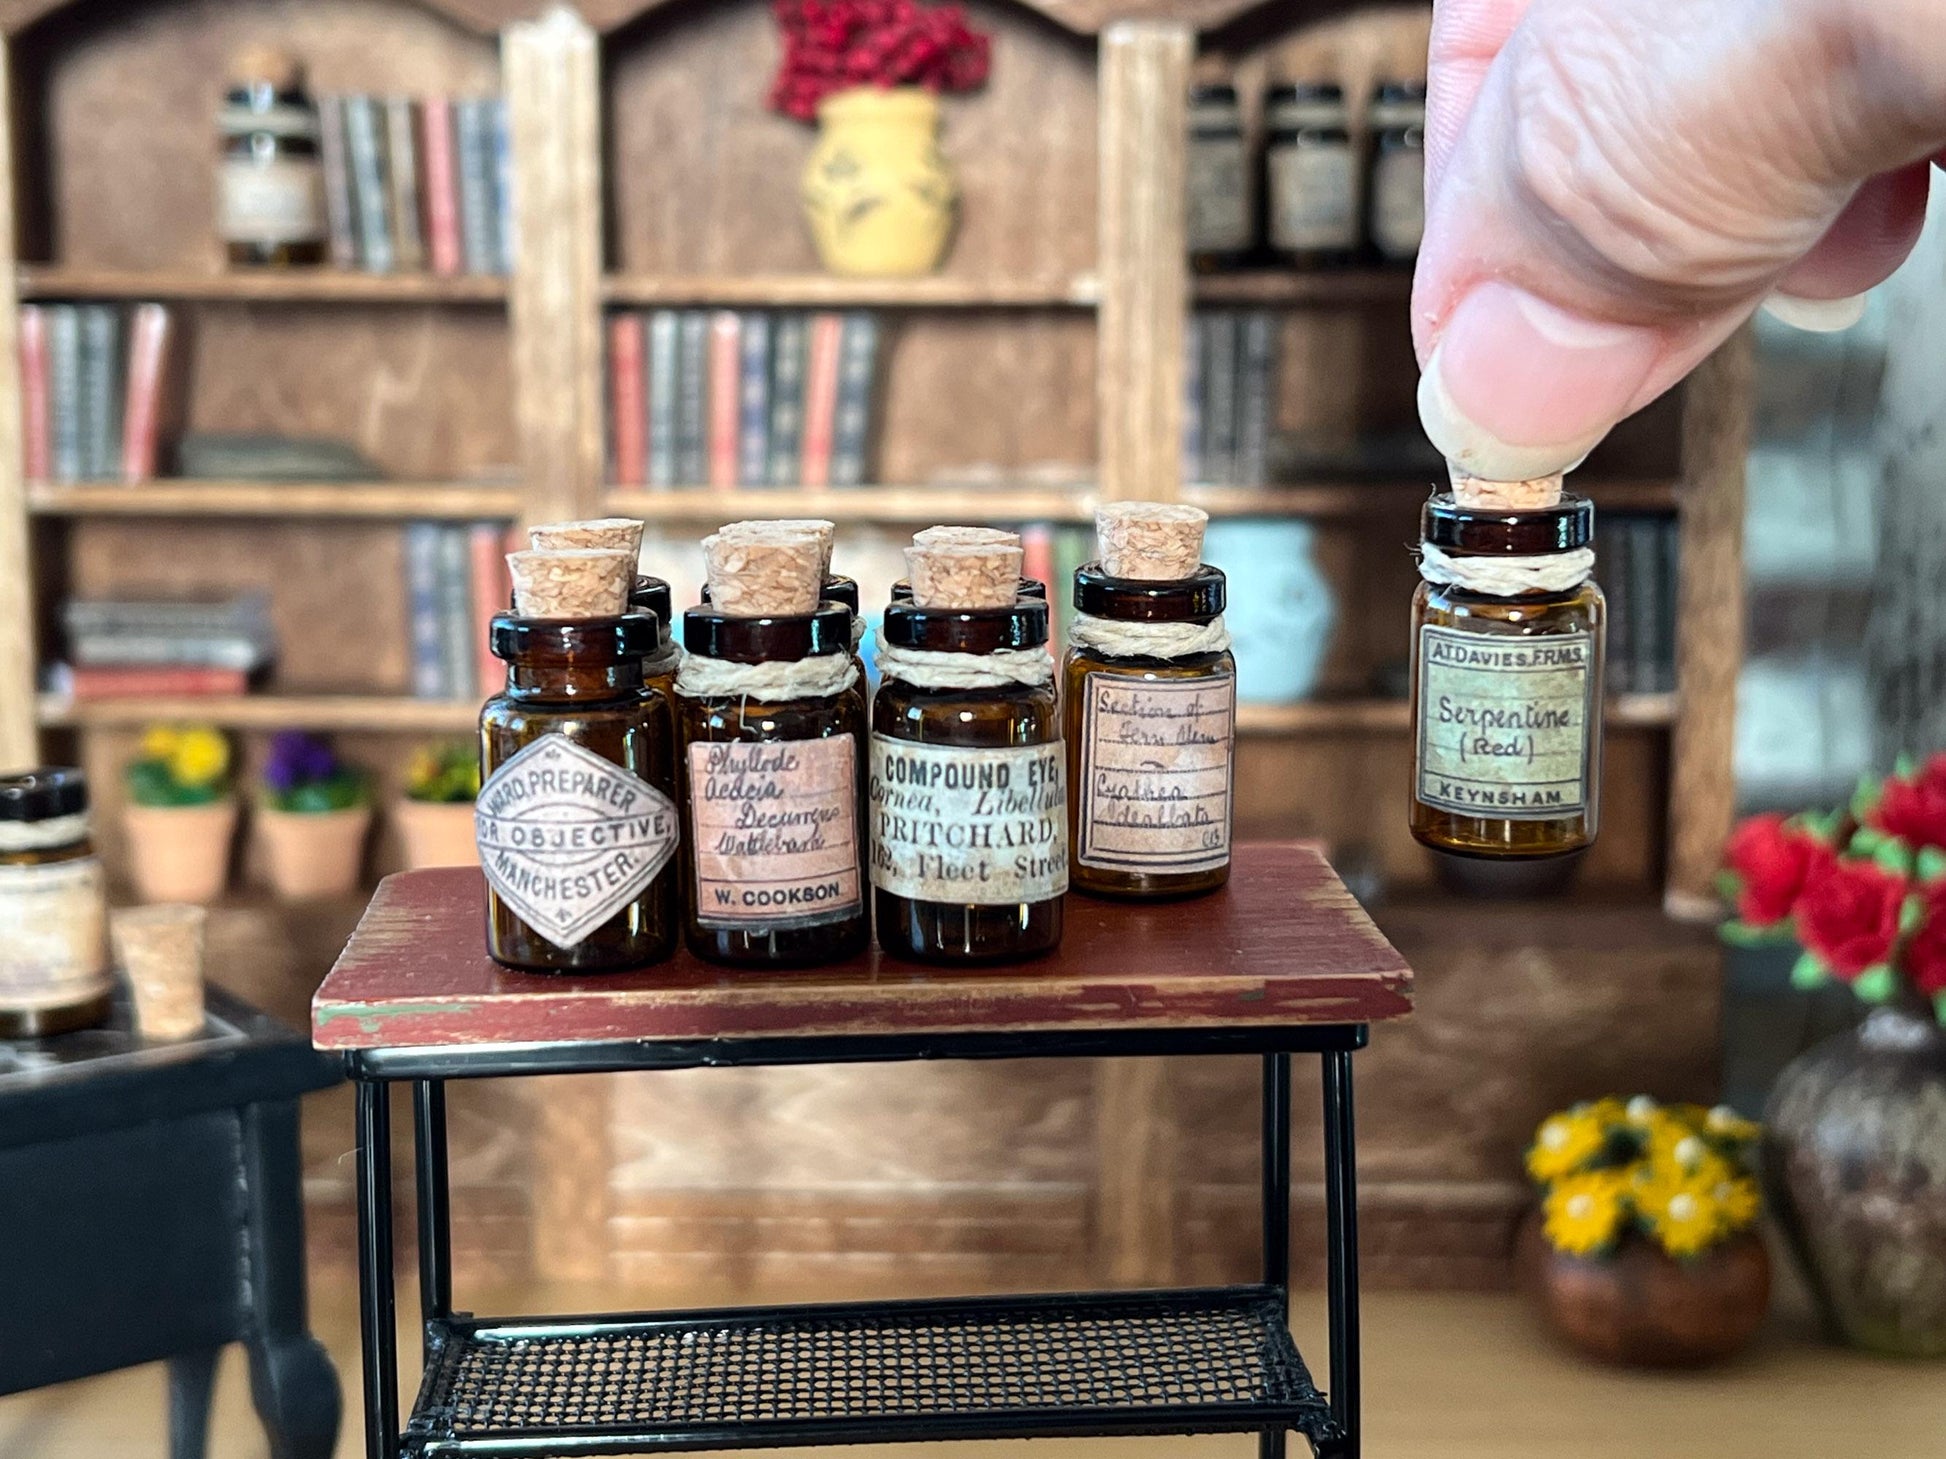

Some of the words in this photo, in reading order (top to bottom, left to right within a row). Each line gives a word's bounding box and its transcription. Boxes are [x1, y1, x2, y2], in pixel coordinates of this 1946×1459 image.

[1439, 696, 1570, 735] Serpentine
[1459, 731, 1534, 765] (Red)
[886, 754, 1011, 790] COMPOUND
[1440, 780, 1562, 805] KEYNSHAM
[919, 852, 990, 882] Fleet
[715, 887, 737, 906] W.
[742, 881, 840, 906] COOKSON
